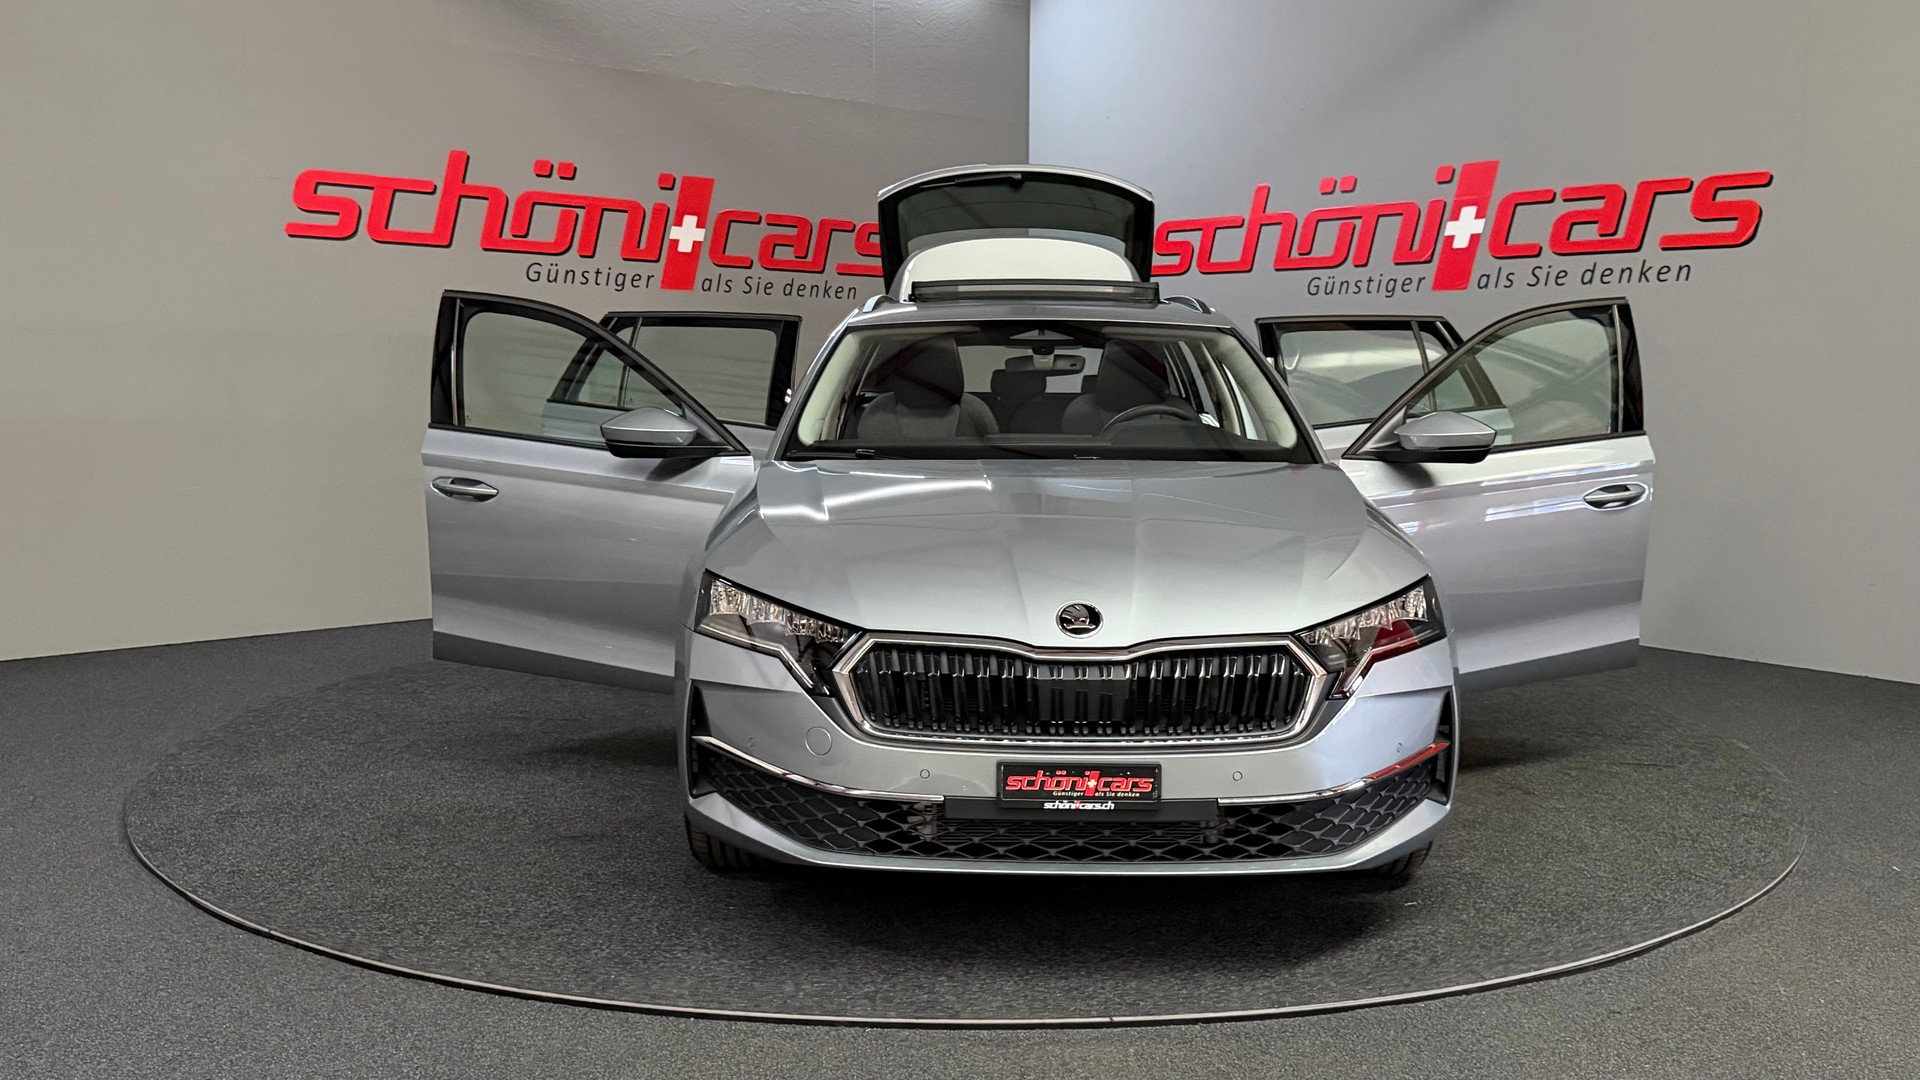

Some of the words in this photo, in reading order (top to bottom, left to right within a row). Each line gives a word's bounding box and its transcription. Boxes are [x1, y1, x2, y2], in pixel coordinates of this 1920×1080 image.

[1487, 169, 1774, 259] cars
[525, 262, 656, 293] Günstiger
[701, 272, 733, 294] als
[742, 275, 774, 296] Sie
[782, 277, 858, 300] denken
[1307, 274, 1427, 299] Günstiger
[1477, 266, 1515, 290] als
[1526, 264, 1569, 288] Sie
[1580, 260, 1692, 286] denken
[1052, 790, 1084, 798] Günstiger
